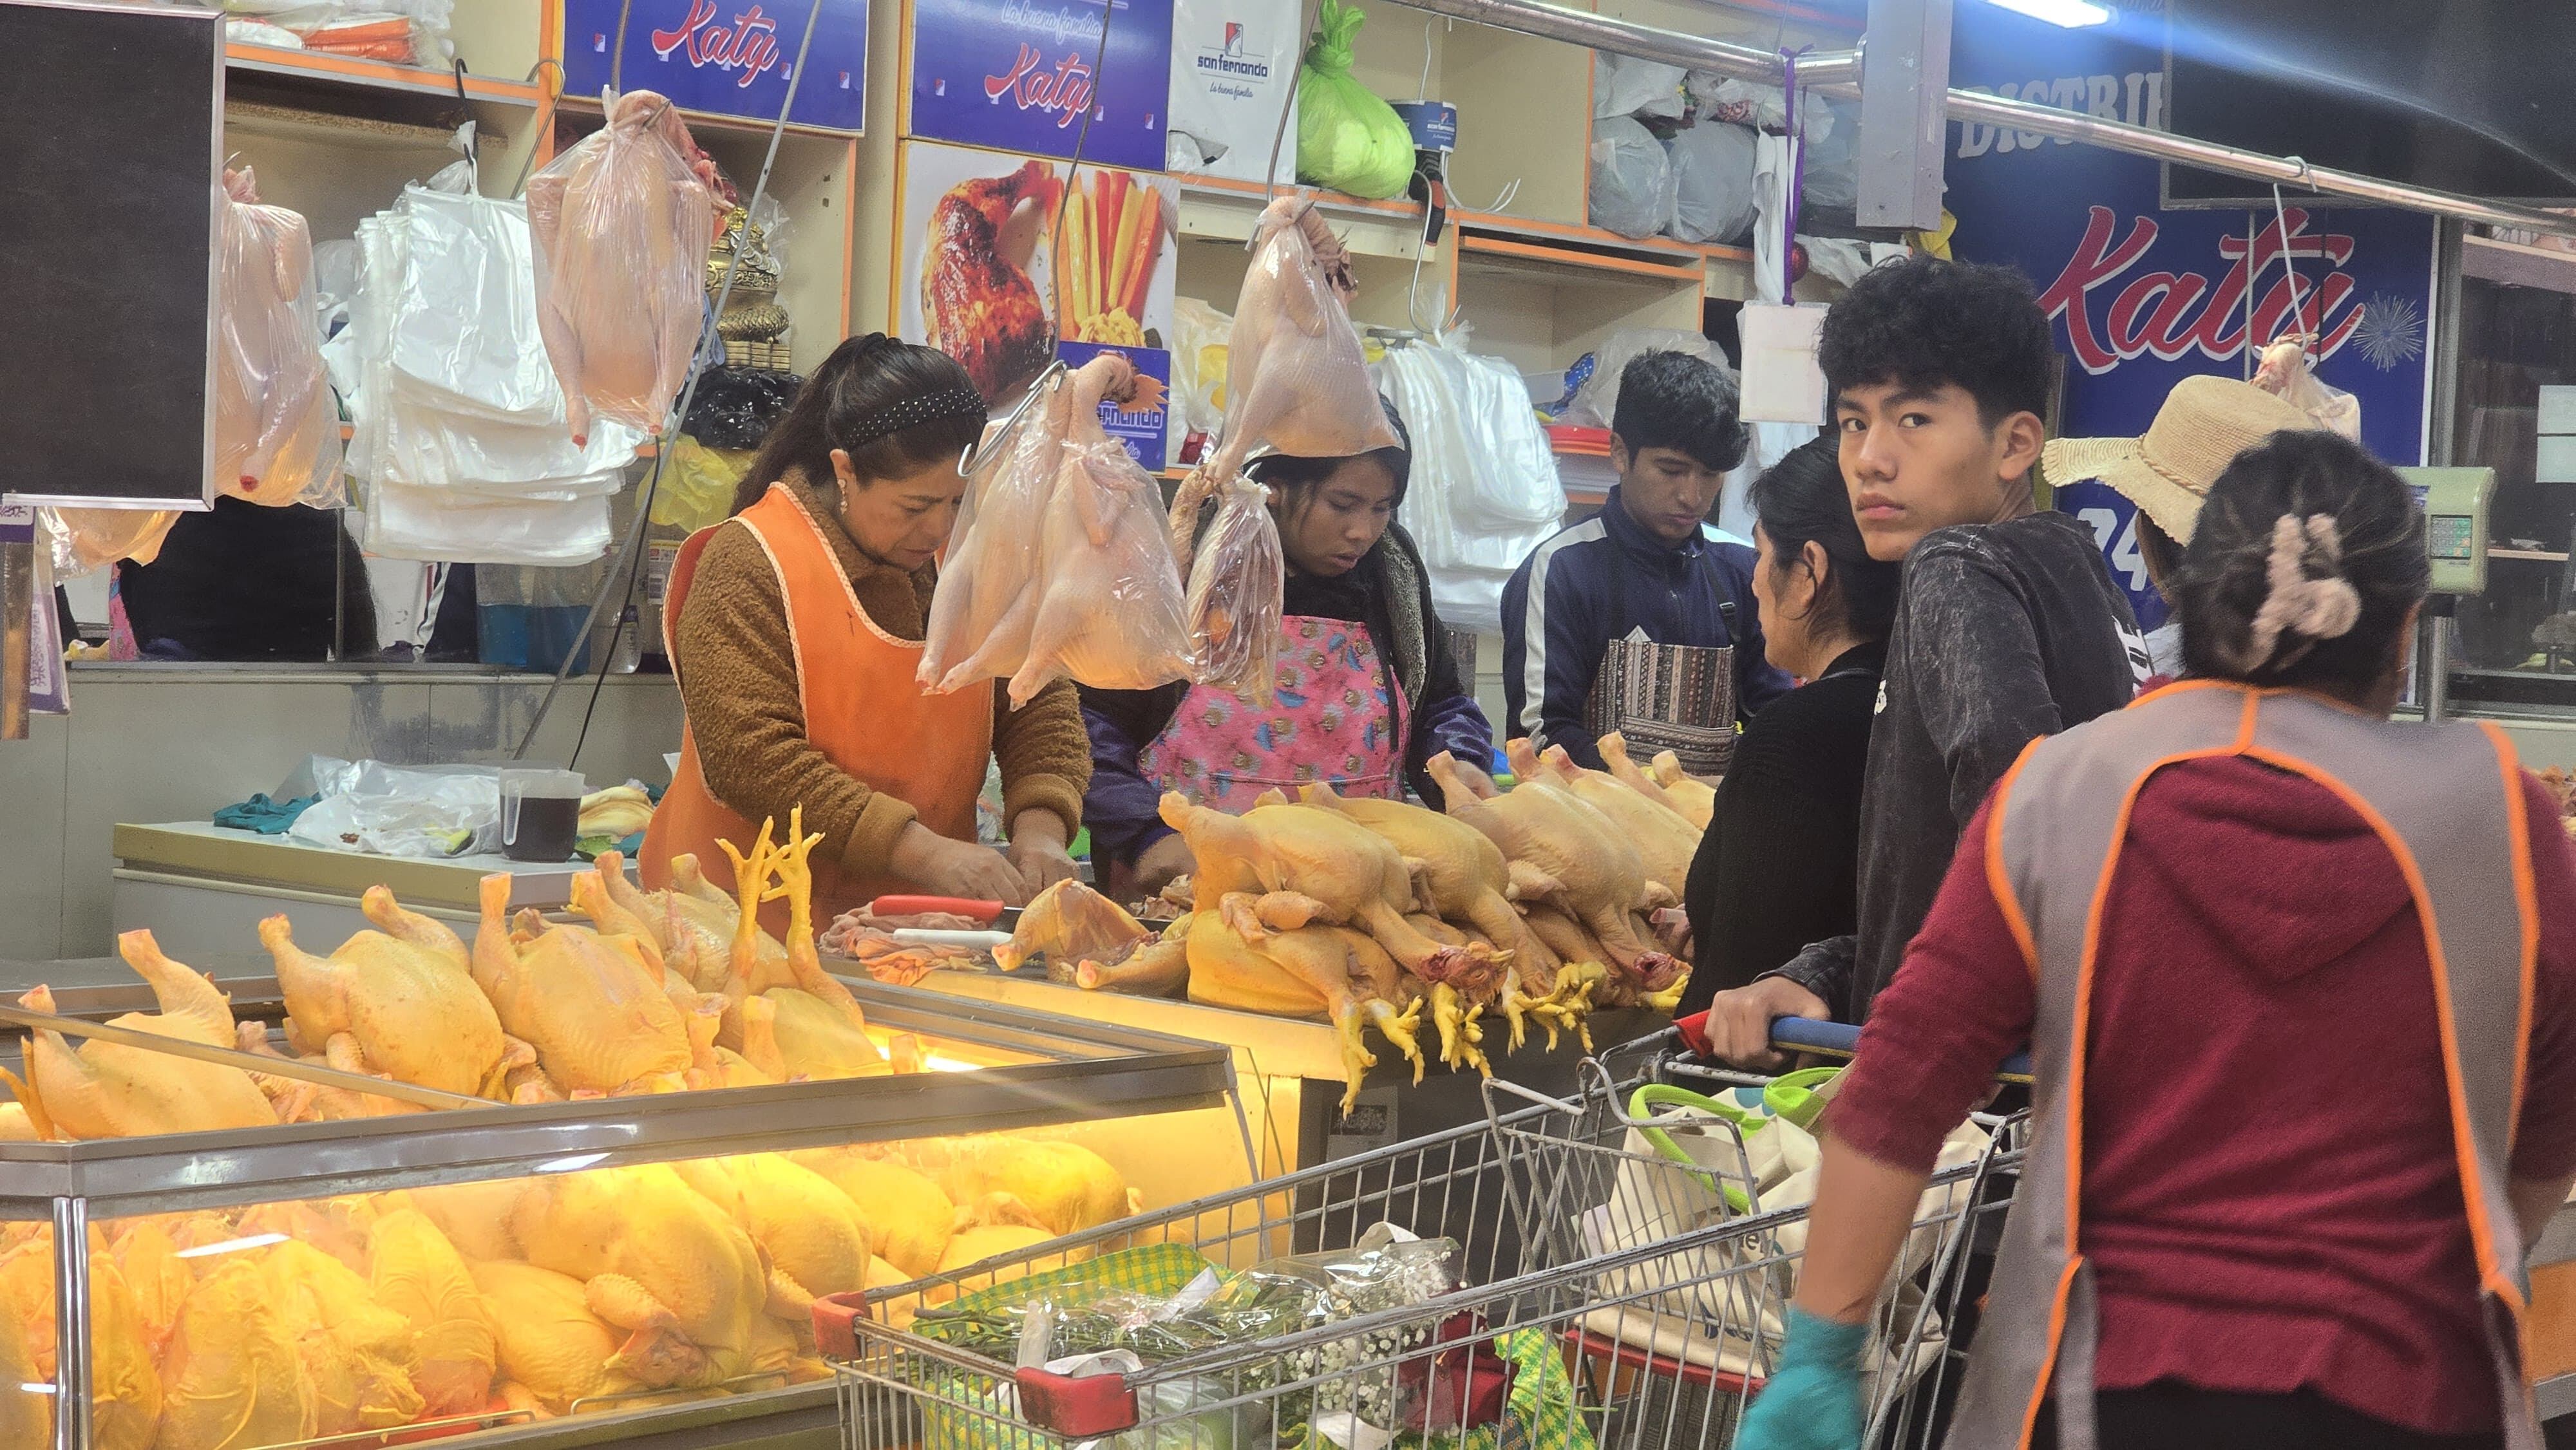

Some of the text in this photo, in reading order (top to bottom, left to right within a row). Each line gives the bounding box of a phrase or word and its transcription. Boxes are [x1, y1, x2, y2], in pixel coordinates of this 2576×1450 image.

[652, 0, 779, 88] Katy
[1019, 0, 1056, 32] buena
[1054, 6, 1103, 45] familia
[985, 42, 1094, 129] Katy
